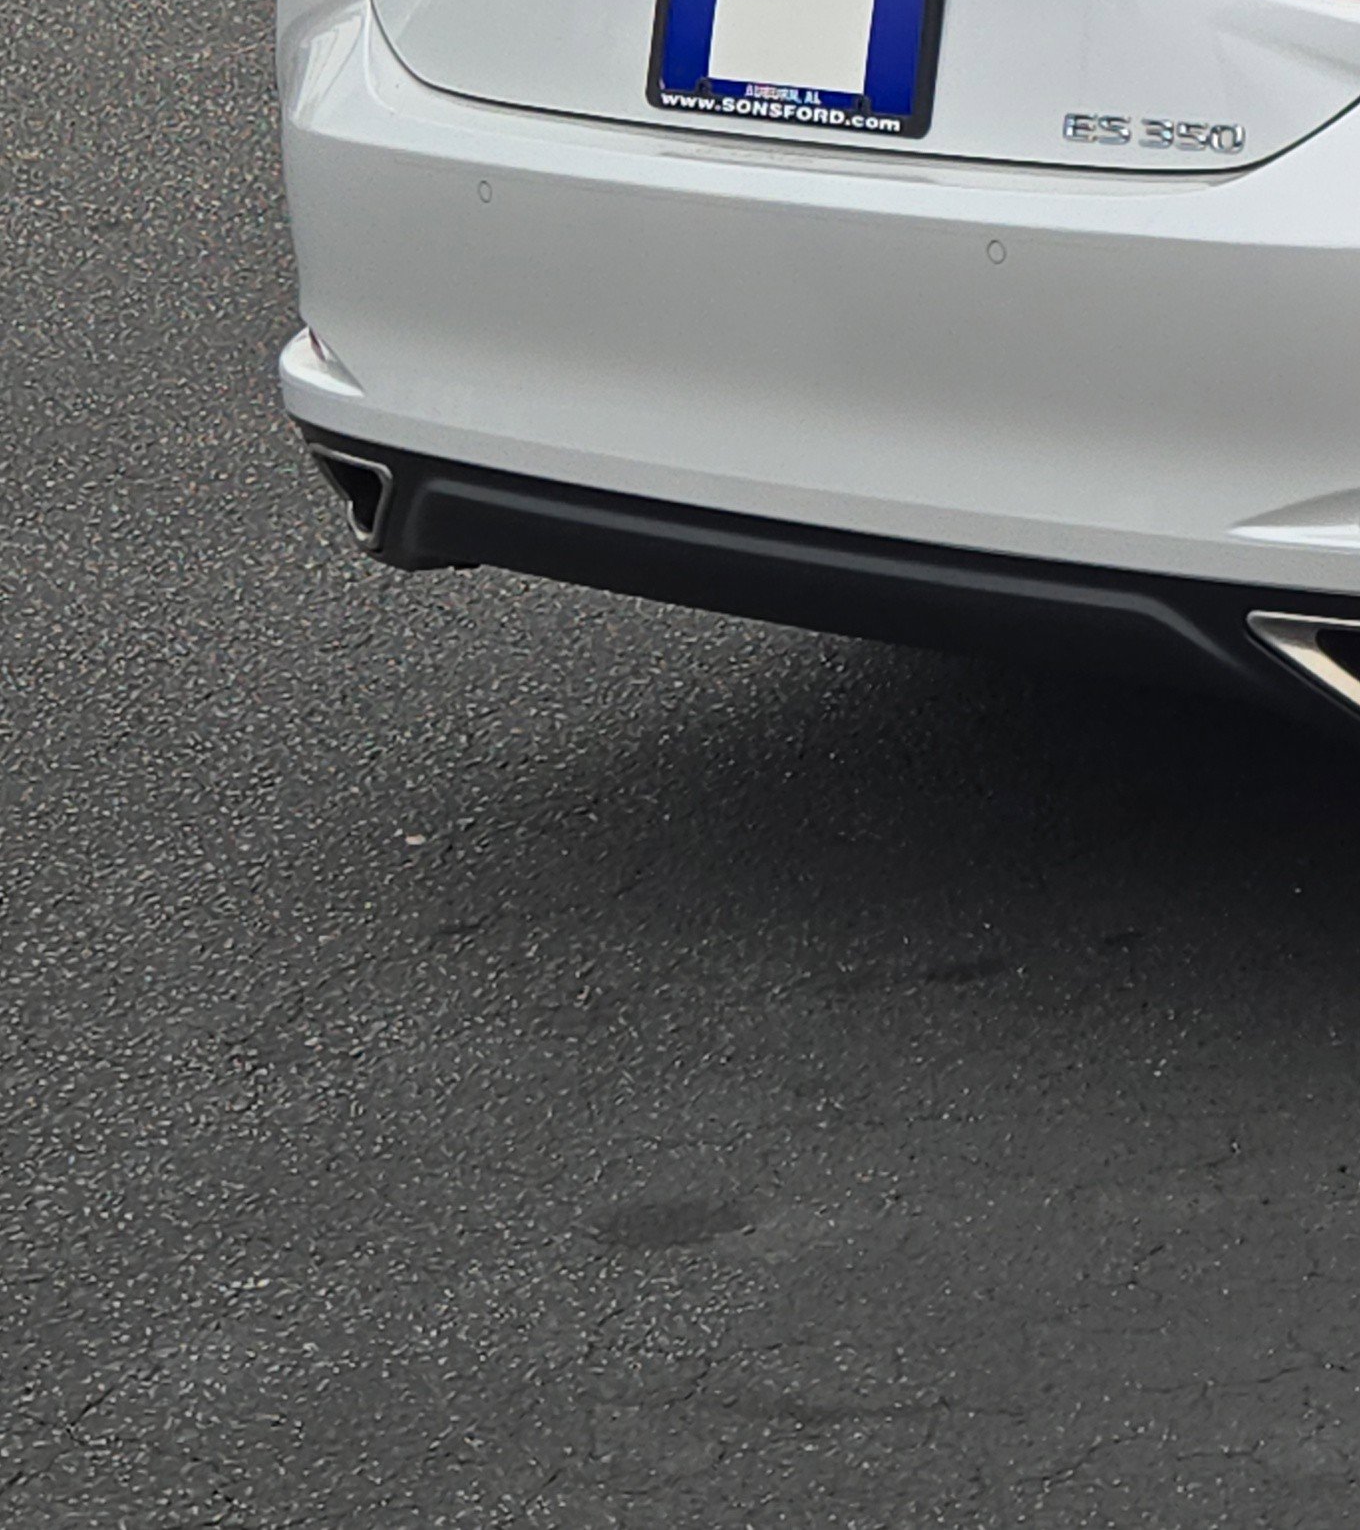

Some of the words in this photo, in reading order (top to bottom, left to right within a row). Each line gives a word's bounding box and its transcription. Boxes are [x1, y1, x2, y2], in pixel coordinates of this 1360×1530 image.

[661, 93, 901, 132] www.SONSFORD.com
[1063, 113, 1131, 145] ES
[1138, 119, 1246, 154] 350
